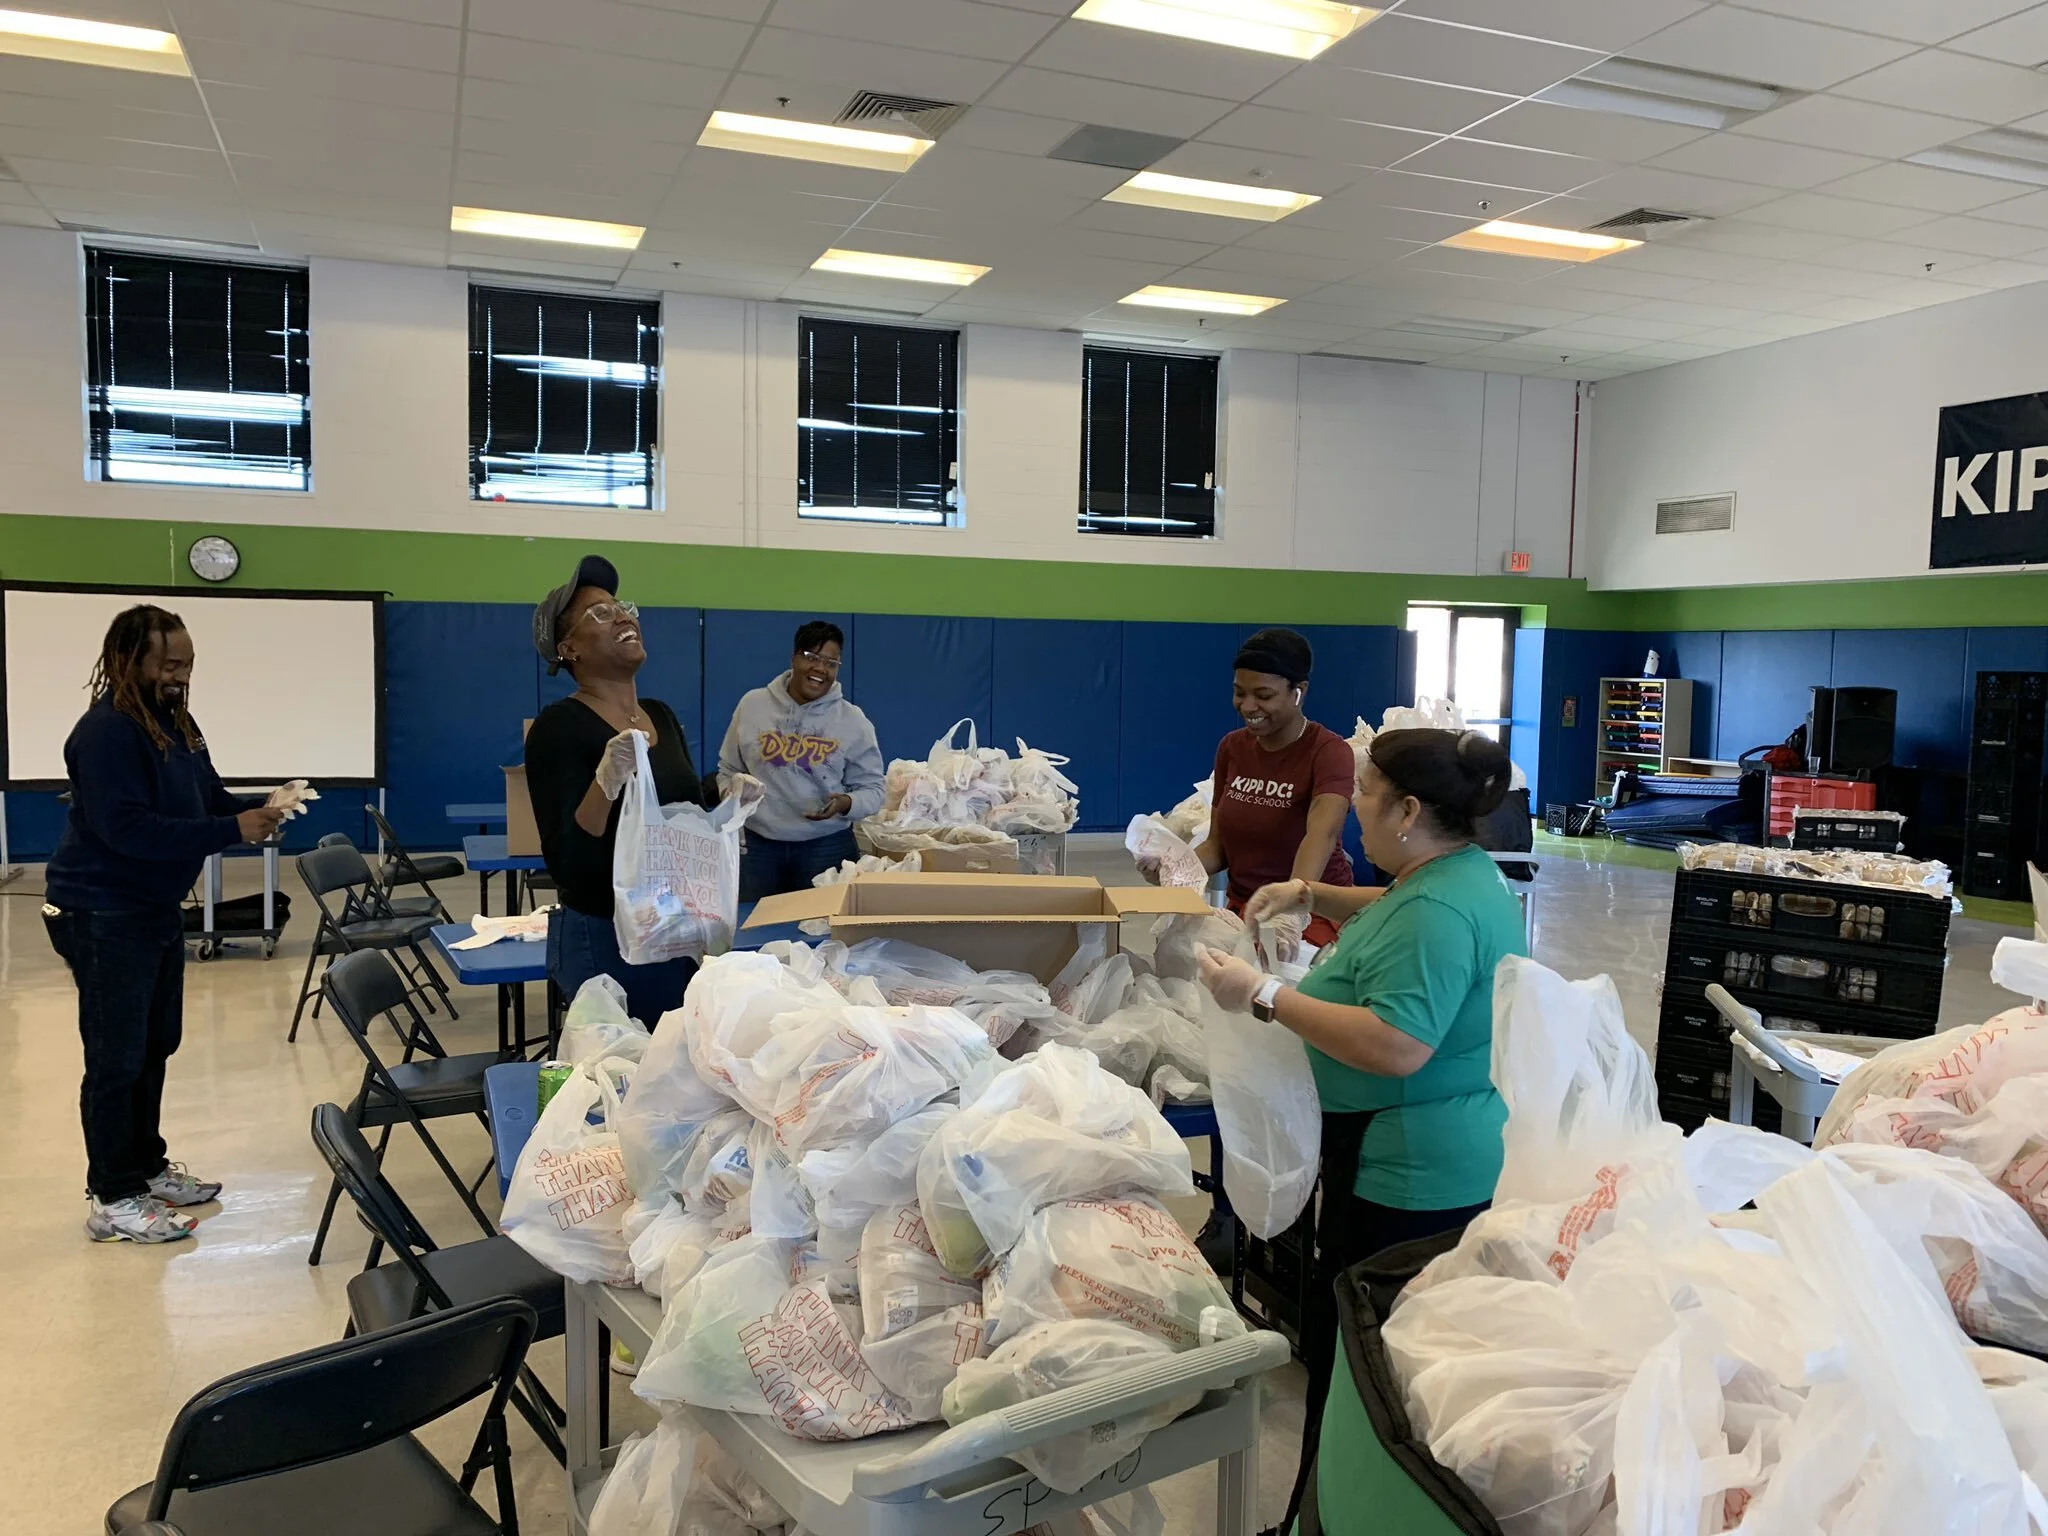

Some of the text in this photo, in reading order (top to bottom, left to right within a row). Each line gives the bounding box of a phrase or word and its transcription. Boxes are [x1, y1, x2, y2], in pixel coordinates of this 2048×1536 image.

[1511, 552, 1530, 571] EXIT
[1231, 776, 1264, 794] KIPP
[1226, 790, 1292, 808] PUBLIC SCHOOLS
[692, 834, 721, 860] YOU
[1058, 1262, 1096, 1291] PLEASE
[1095, 1283, 1136, 1310] RETURN
[1136, 1305, 1150, 1317] TO
[1083, 1290, 1114, 1311] STORE
[1115, 1309, 1134, 1324] FOR
